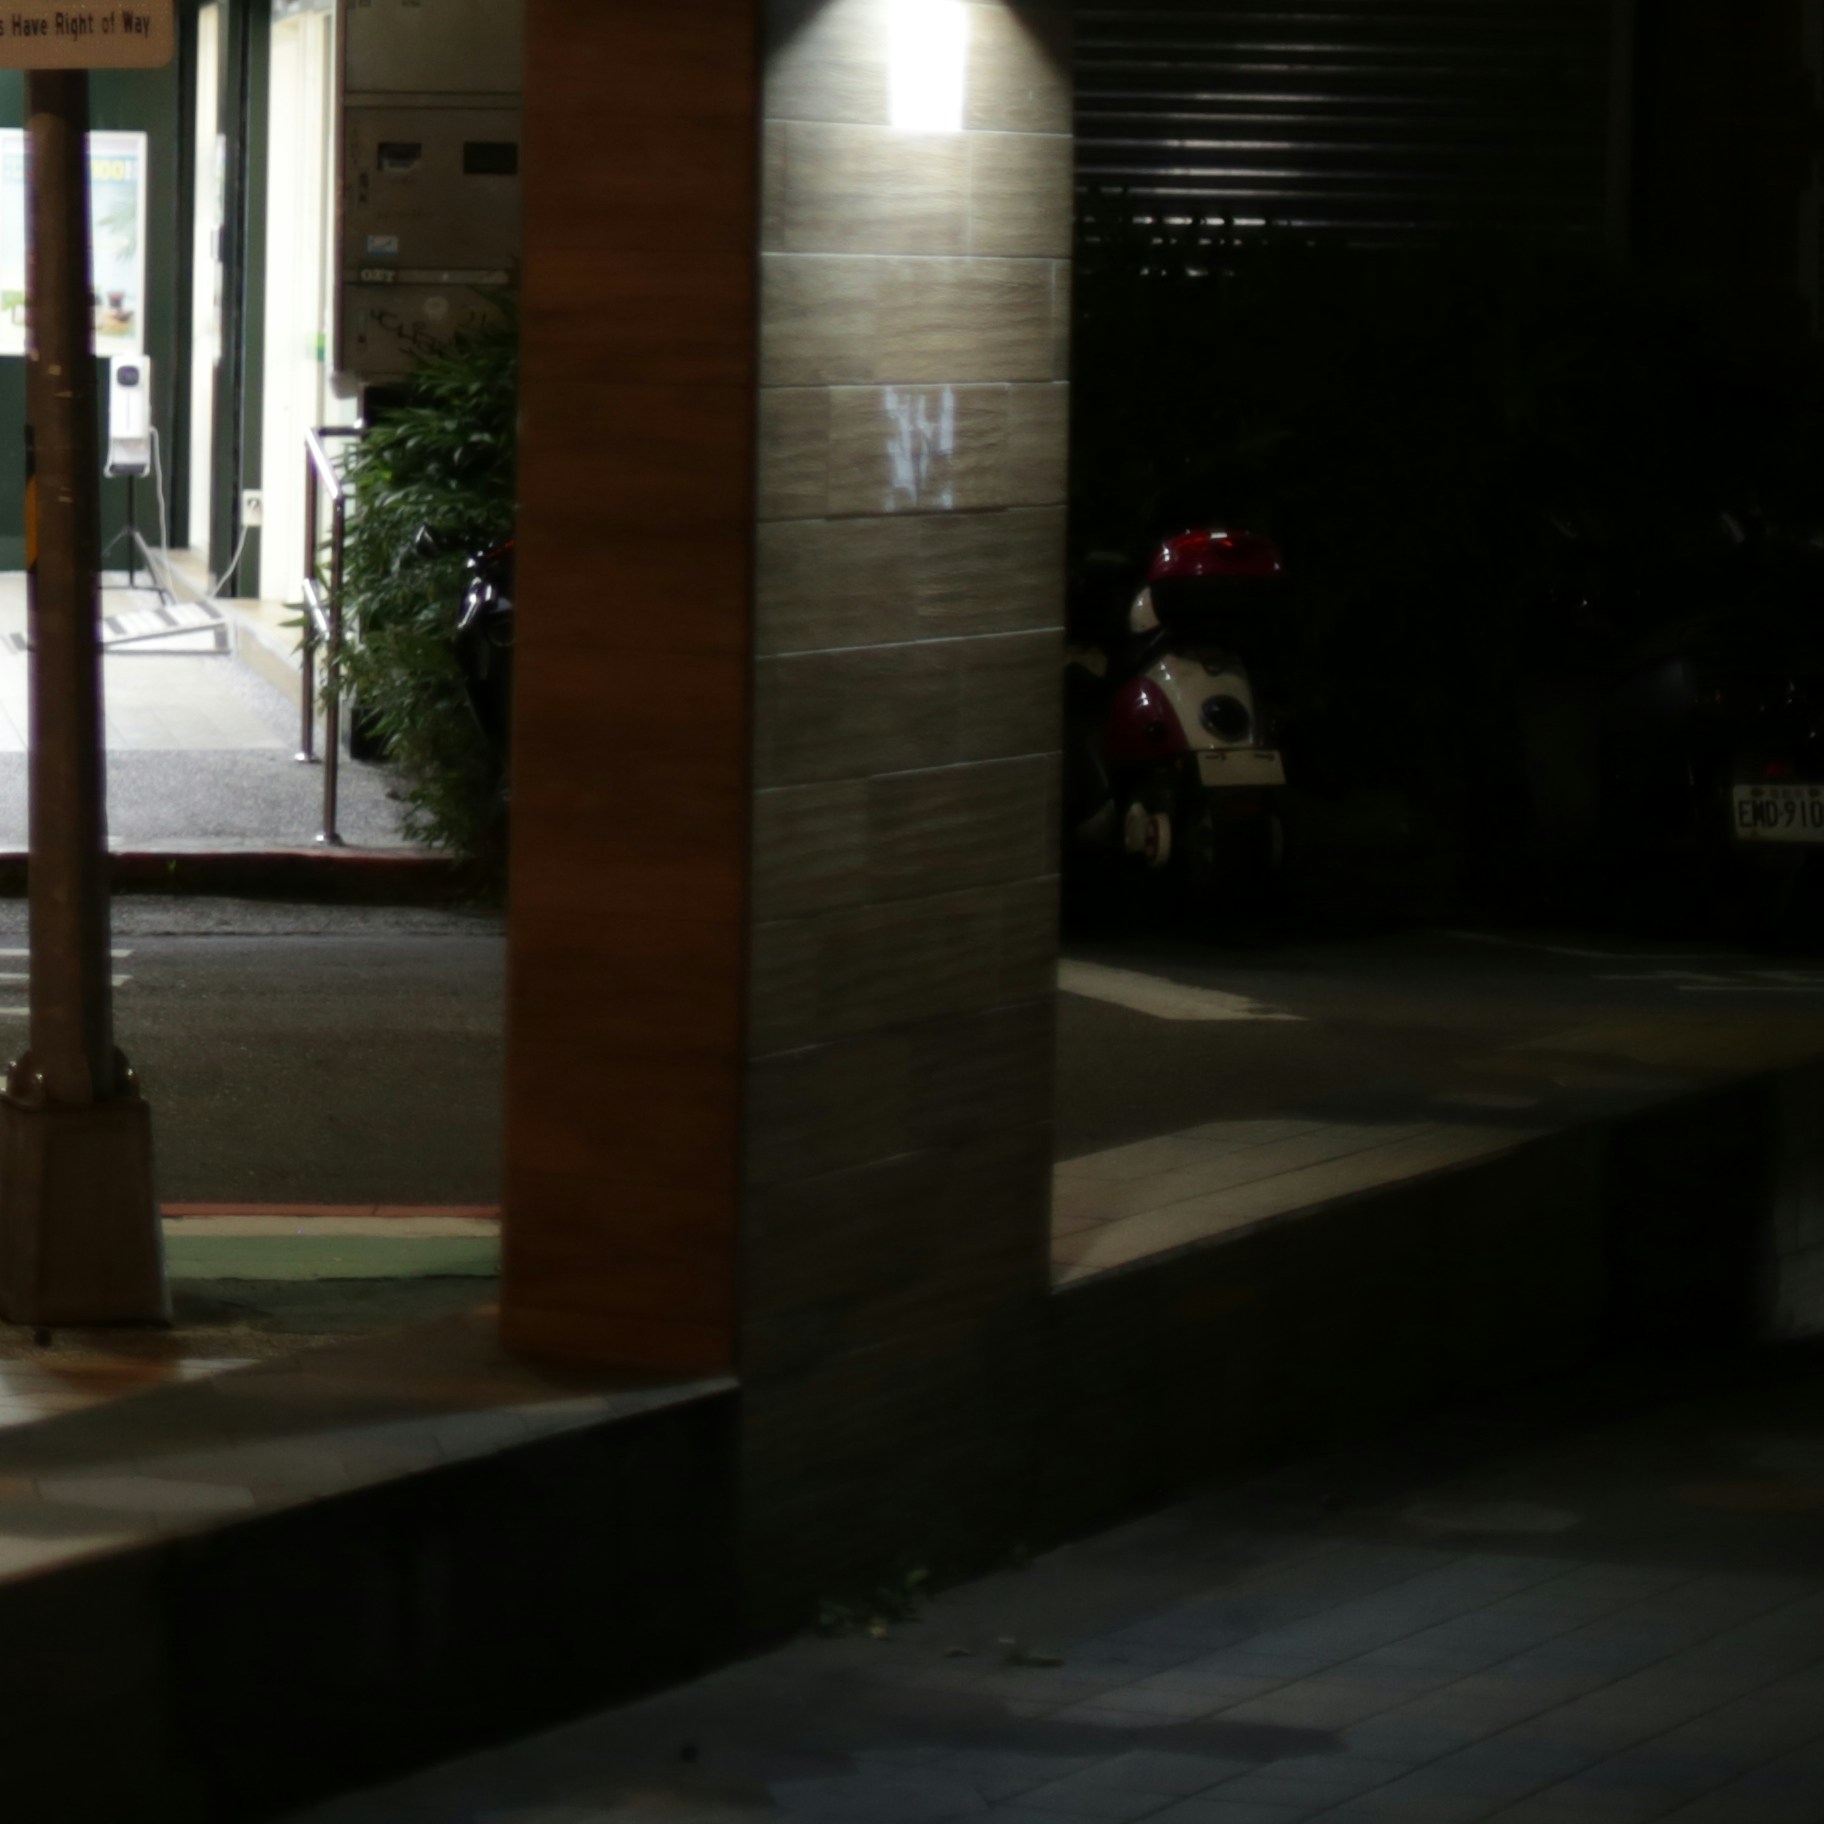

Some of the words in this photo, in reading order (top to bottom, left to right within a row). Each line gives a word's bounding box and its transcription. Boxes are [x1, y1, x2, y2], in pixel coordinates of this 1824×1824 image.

[11, 13, 48, 36] Have
[55, 12, 94, 42] Right
[102, 11, 116, 34] of
[122, 10, 151, 39] Way
